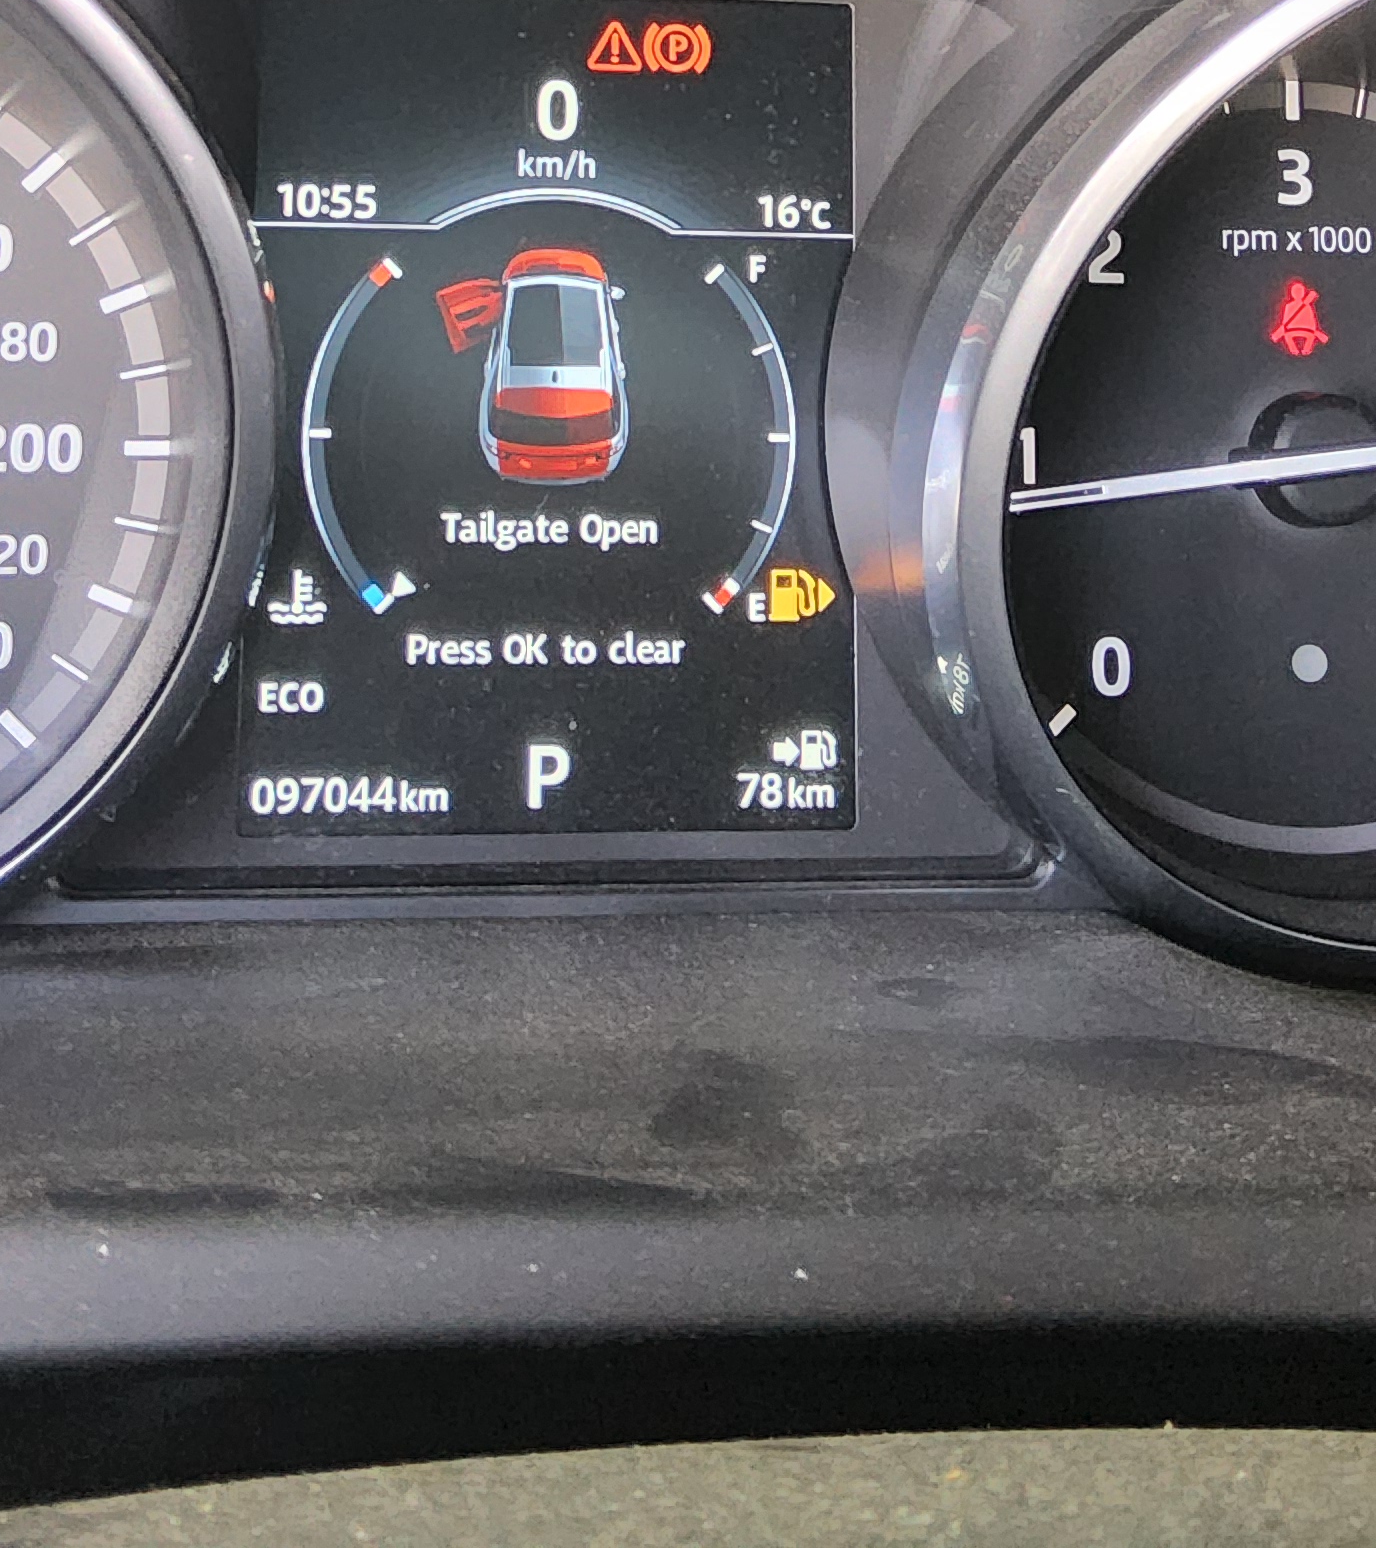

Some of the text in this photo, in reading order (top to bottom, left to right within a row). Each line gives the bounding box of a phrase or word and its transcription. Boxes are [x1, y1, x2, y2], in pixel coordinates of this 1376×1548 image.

[537, 79, 579, 141] 0
[517, 148, 596, 181] km/h
[1277, 148, 1313, 206] 3
[276, 183, 377, 220] 10:55
[1087, 228, 1125, 286] 2
[1221, 225, 1372, 257] rpm x 1000
[749, 254, 767, 284] F
[1019, 426, 1036, 485] 1
[440, 509, 658, 552] Tailgate Open
[747, 592, 767, 623] E
[406, 631, 686, 665] Press OK to clear
[1091, 636, 1131, 697] 0
[258, 681, 324, 713] ECO
[527, 743, 571, 810] P
